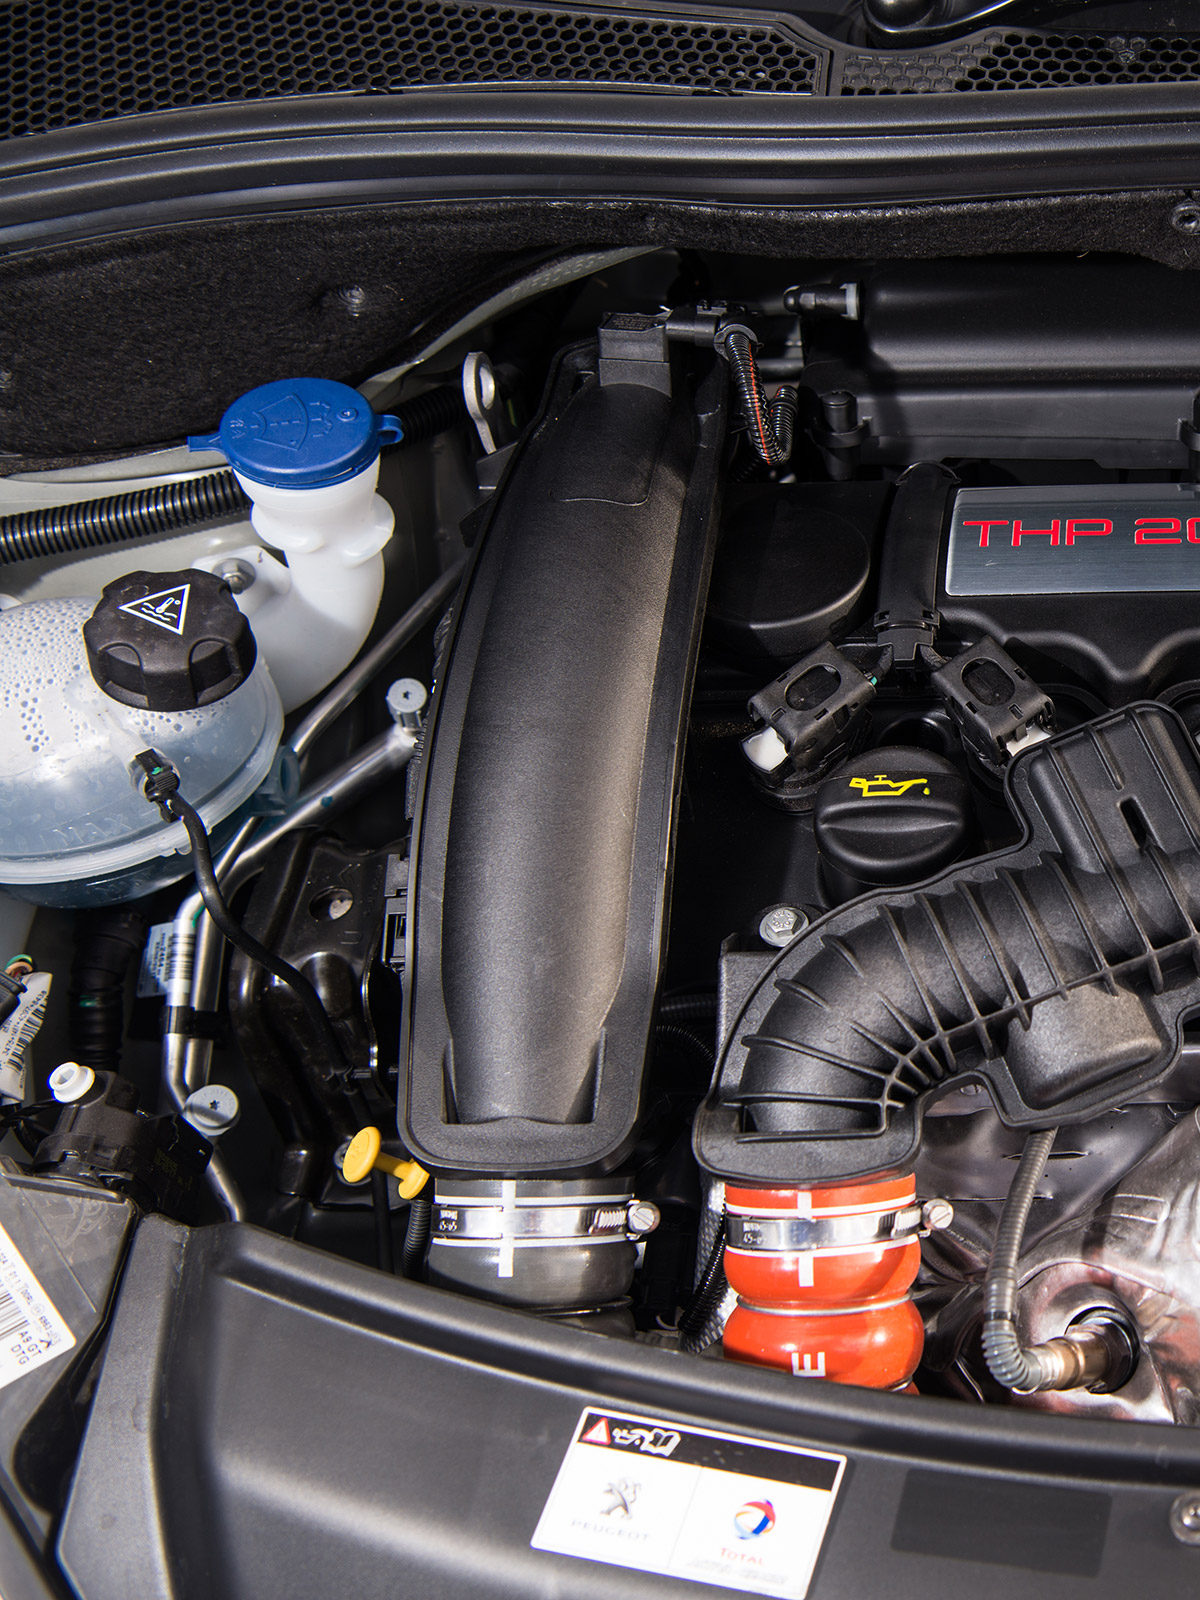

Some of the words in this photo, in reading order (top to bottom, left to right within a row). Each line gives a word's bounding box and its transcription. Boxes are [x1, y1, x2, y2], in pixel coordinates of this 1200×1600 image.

[962, 518, 1114, 549] THP
[10, 1343, 30, 1366] DTG
[27, 1343, 42, 1358] GT
[571, 1519, 652, 1543] PEUGEOT
[720, 1547, 766, 1566] TOTAL
